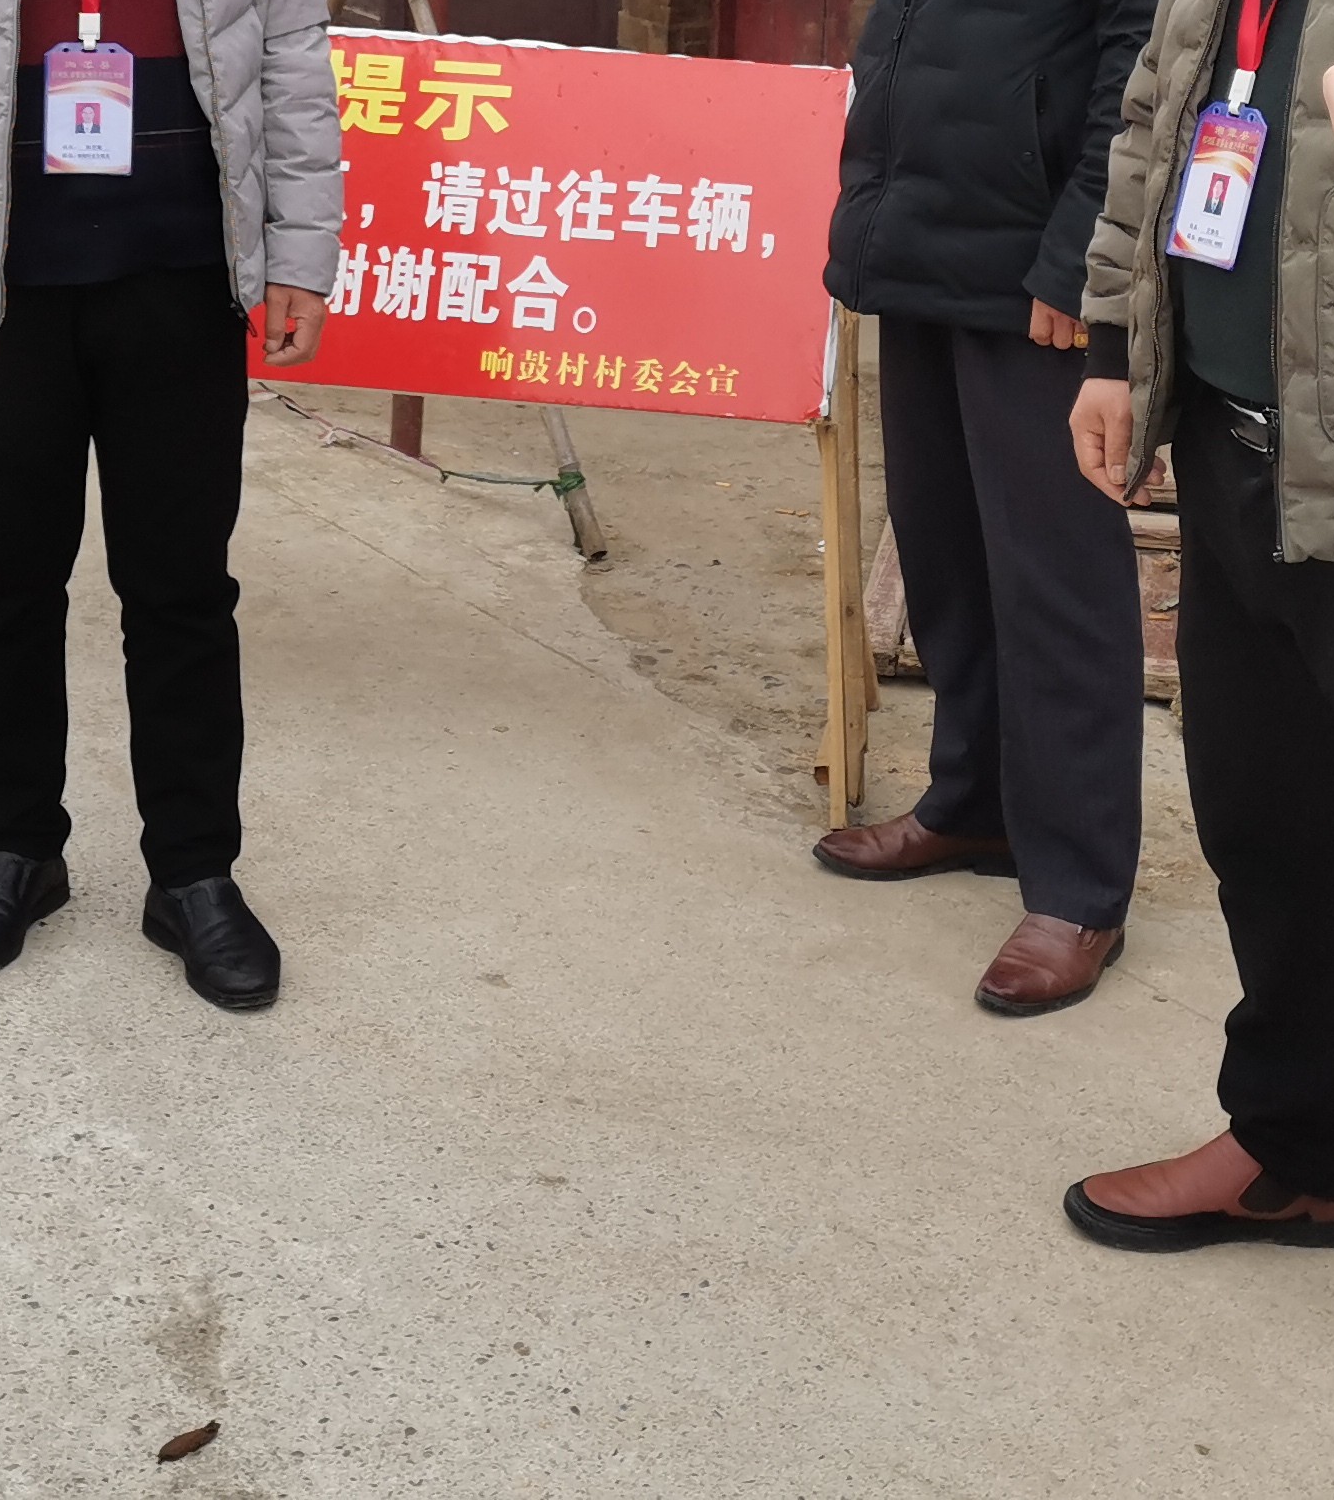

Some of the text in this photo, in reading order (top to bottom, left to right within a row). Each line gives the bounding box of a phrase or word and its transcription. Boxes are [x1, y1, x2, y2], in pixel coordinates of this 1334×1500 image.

[329, 49, 513, 141] 提示
[340, 160, 776, 259] ，请过往车辆，
[479, 345, 740, 398] 响鼓村村委会宣
